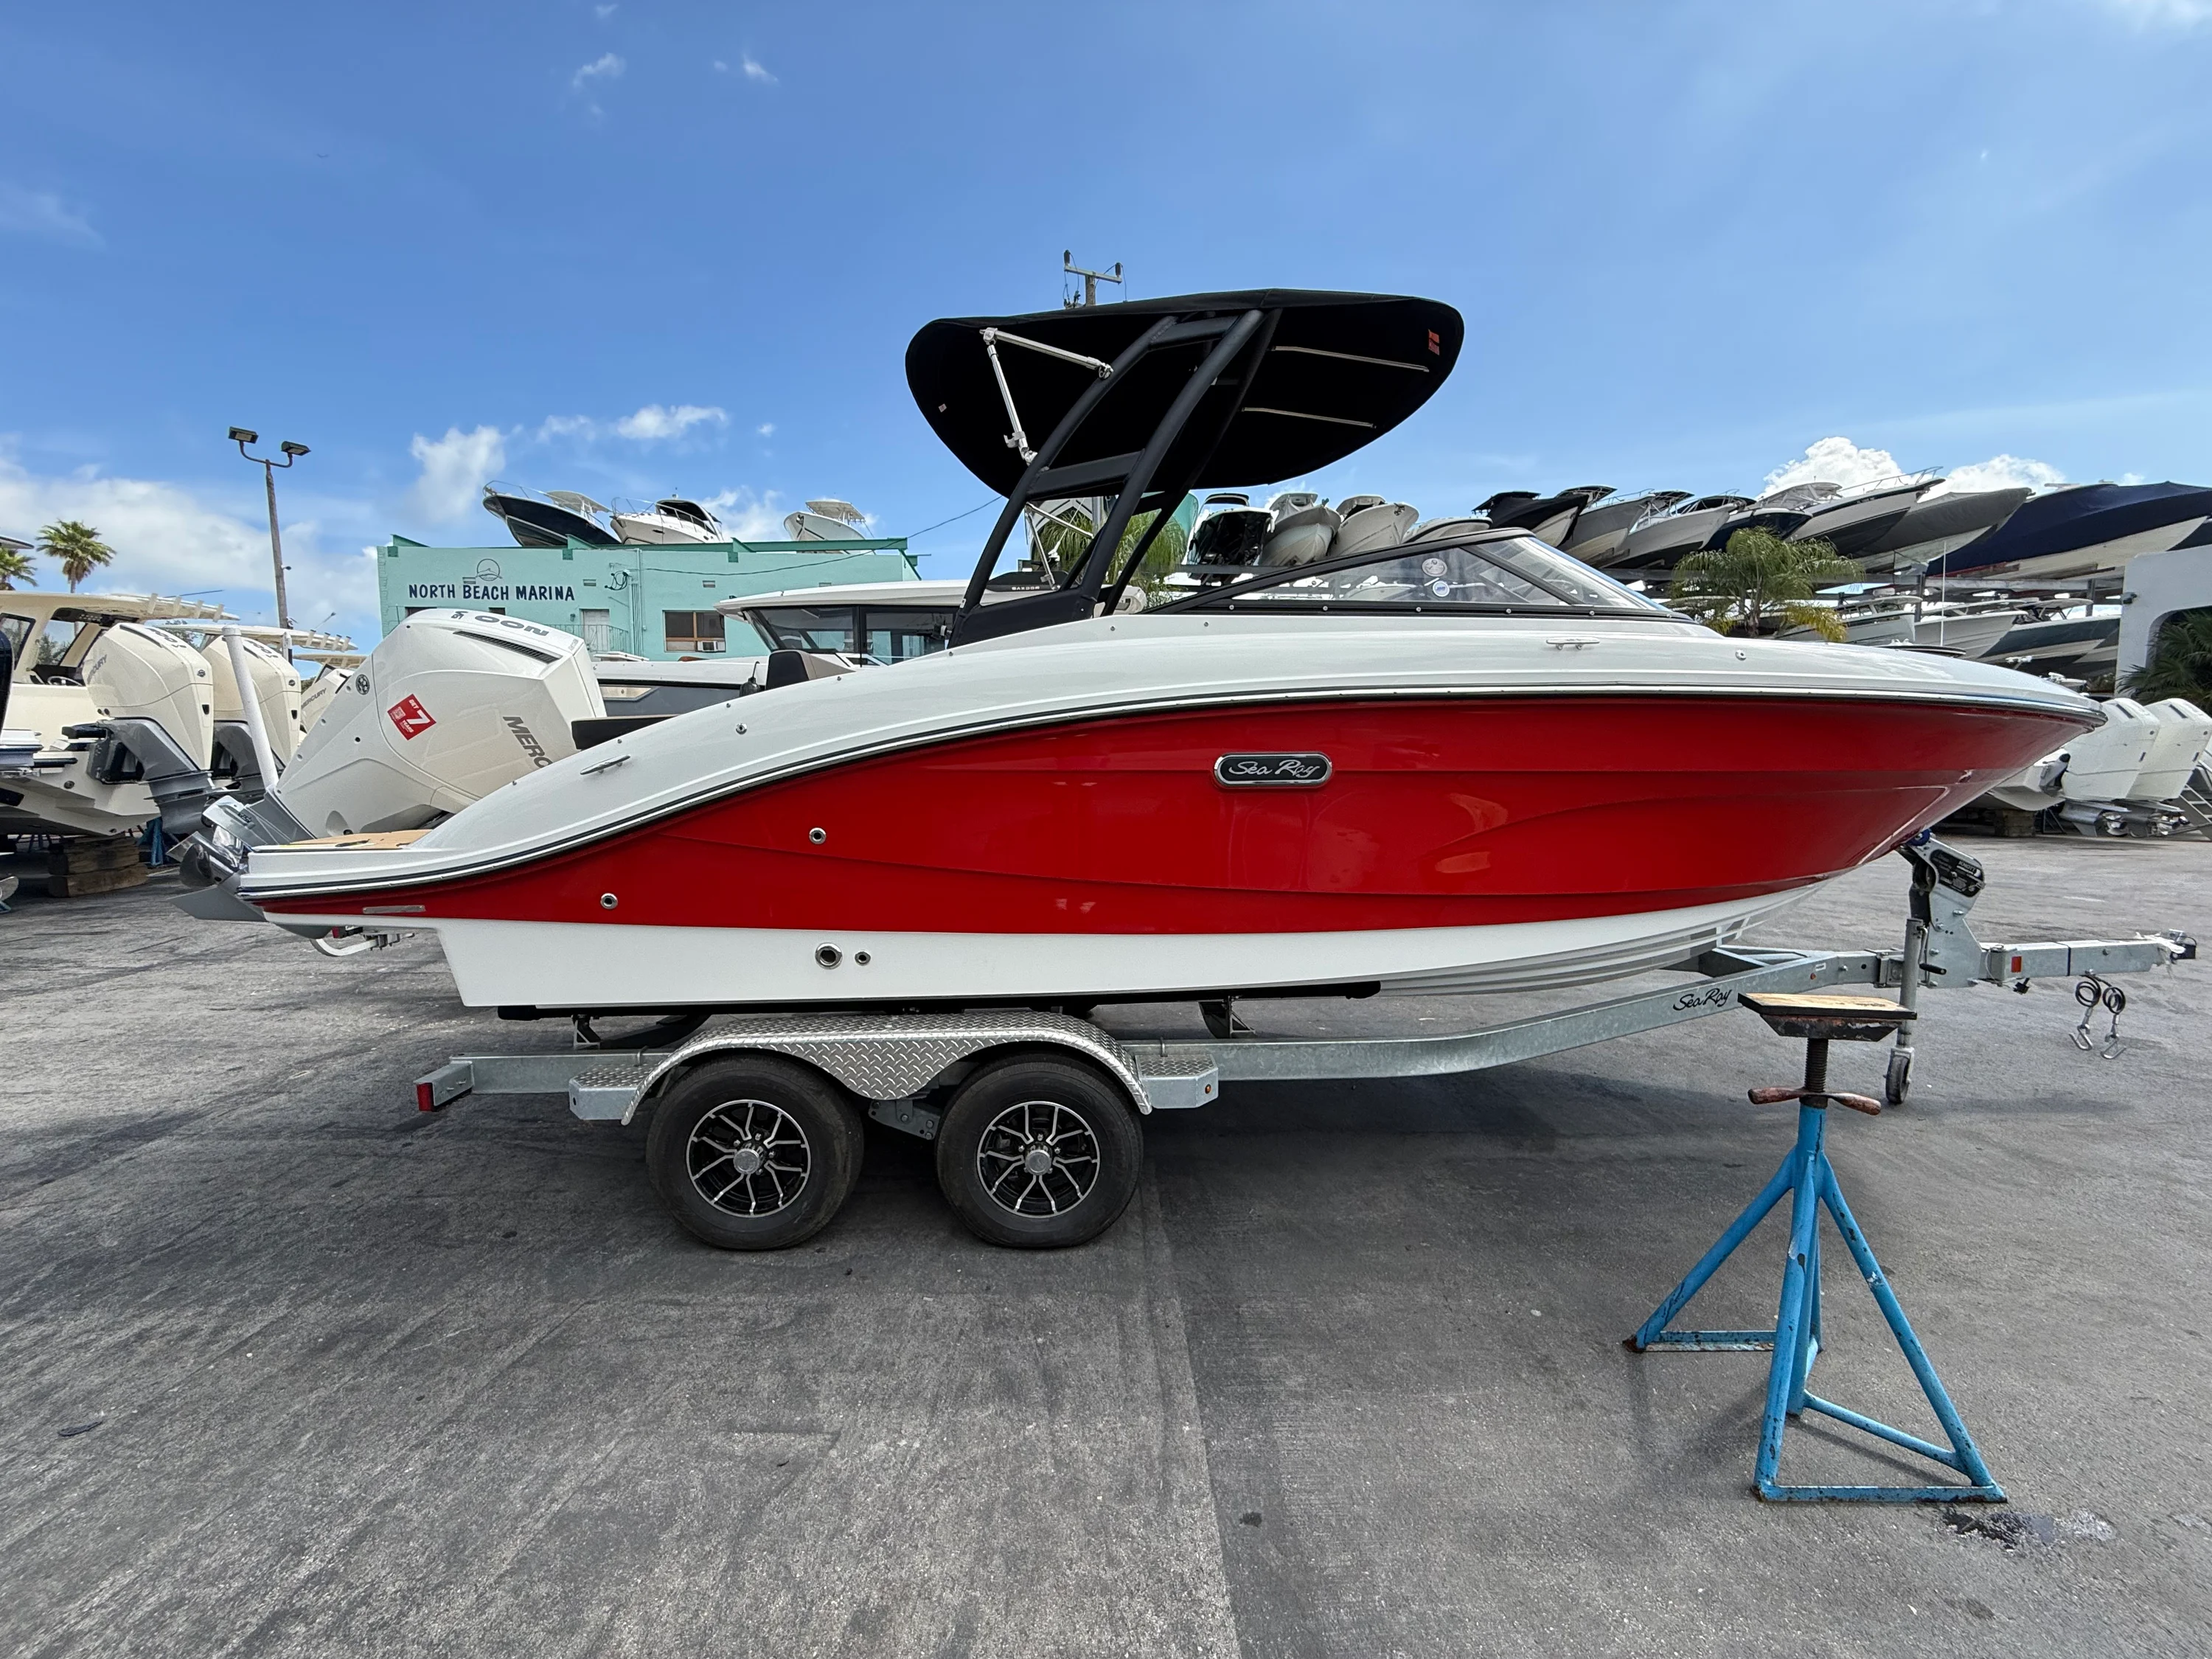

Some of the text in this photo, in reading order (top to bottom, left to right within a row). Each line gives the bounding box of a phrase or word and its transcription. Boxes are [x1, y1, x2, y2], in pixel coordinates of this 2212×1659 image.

[408, 584, 575, 602] NORTH BEACH MARINA
[405, 709, 431, 726] 7
[502, 716, 554, 769] MERC
[1228, 759, 1321, 779] Sea Ray
[1672, 987, 1733, 1012] Sea Ray
